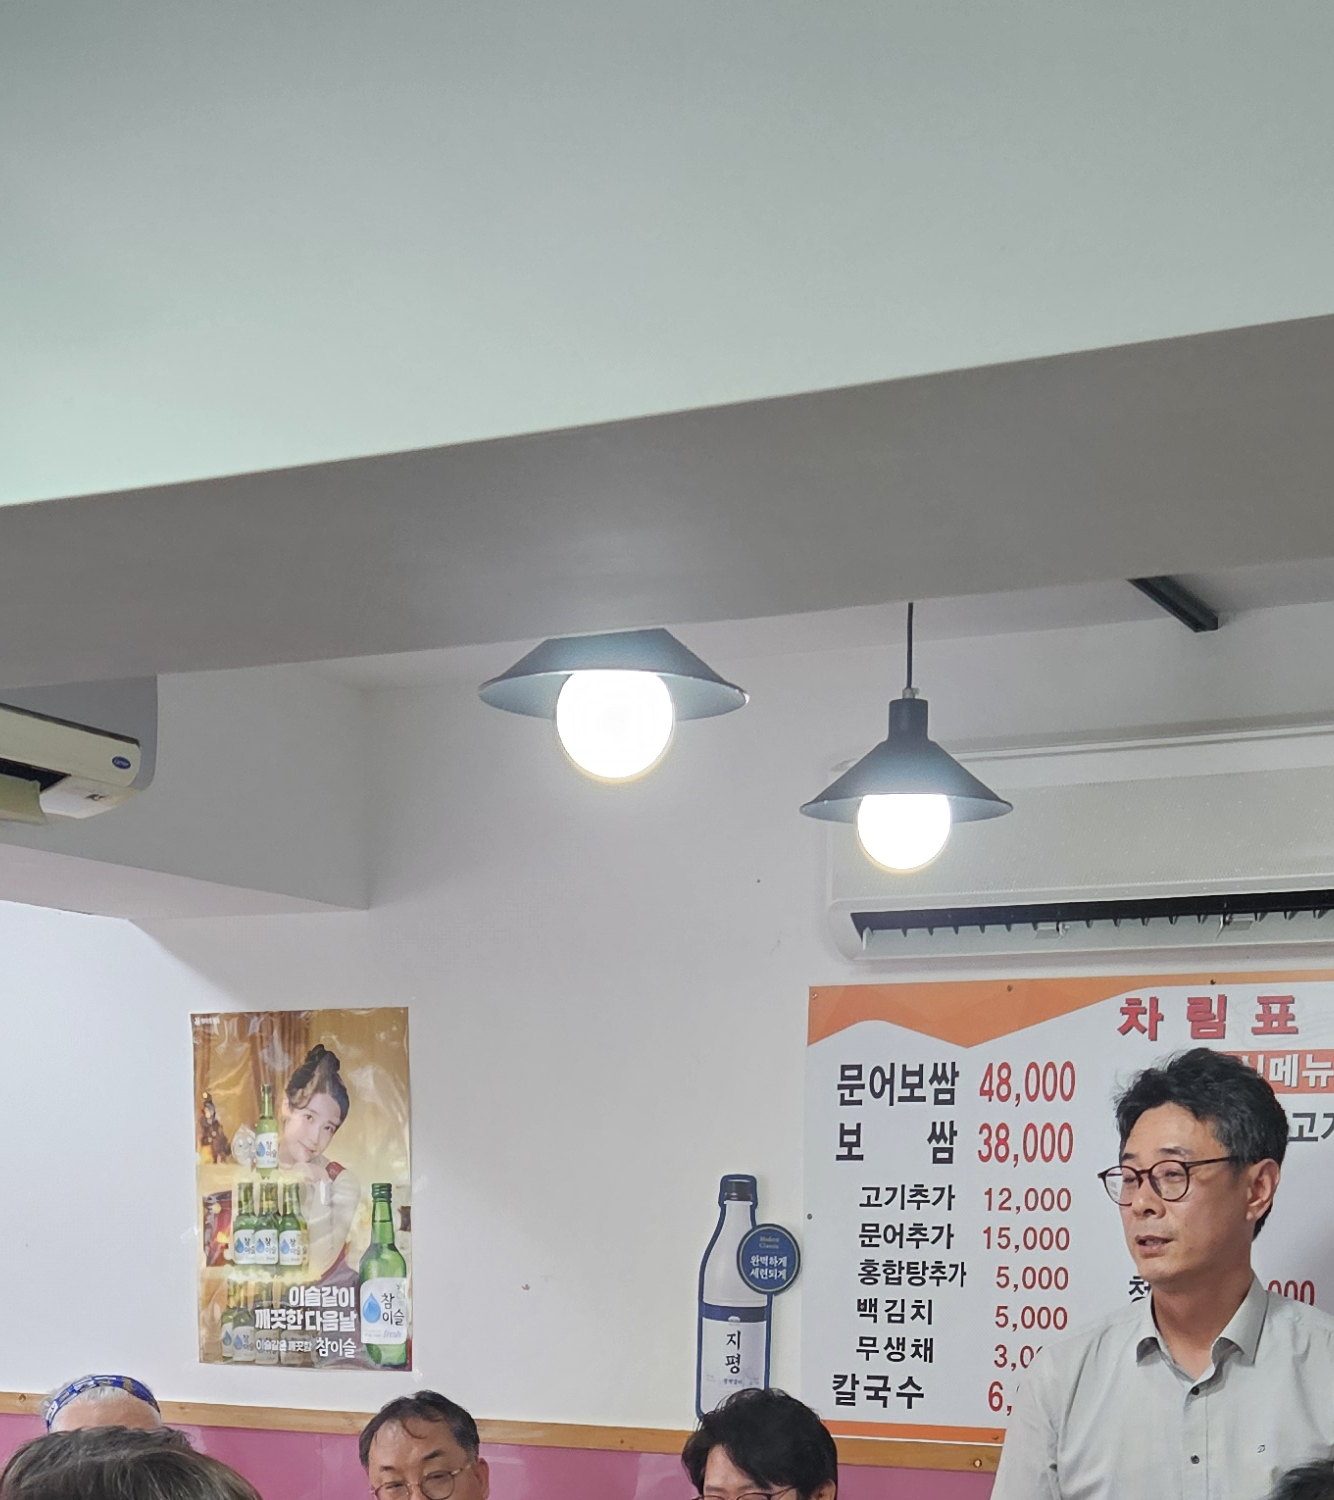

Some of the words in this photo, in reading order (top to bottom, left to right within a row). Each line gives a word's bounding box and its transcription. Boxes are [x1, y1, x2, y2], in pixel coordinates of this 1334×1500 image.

[837, 1061, 960, 1106] 문어보쌈
[979, 1060, 1076, 1107] 48,000
[977, 1122, 1074, 1168] 38,000
[859, 1184, 956, 1211] 고기추가
[984, 1187, 1072, 1215] 12,000
[859, 1223, 955, 1250] 문어추가
[983, 1226, 1070, 1253] 15,000
[750, 1255, 788, 1267] 완벽하게
[858, 1259, 967, 1288] 홍합탕추가
[996, 1266, 1069, 1292] 5,000
[289, 1286, 355, 1308] 이슬같이
[381, 1292, 395, 1310] 참
[254, 1308, 303, 1330] 깨끗한
[305, 1309, 357, 1332] 다음날
[382, 1309, 405, 1327] 이슬
[856, 1298, 933, 1325] 백김치
[995, 1305, 1068, 1332] 5,000
[315, 1336, 357, 1359] 참이슬
[855, 1336, 935, 1363] 무생채
[993, 1344, 1043, 1372] 3,0
[832, 1373, 925, 1409] 칼국수
[988, 1381, 1019, 1415] 6,
